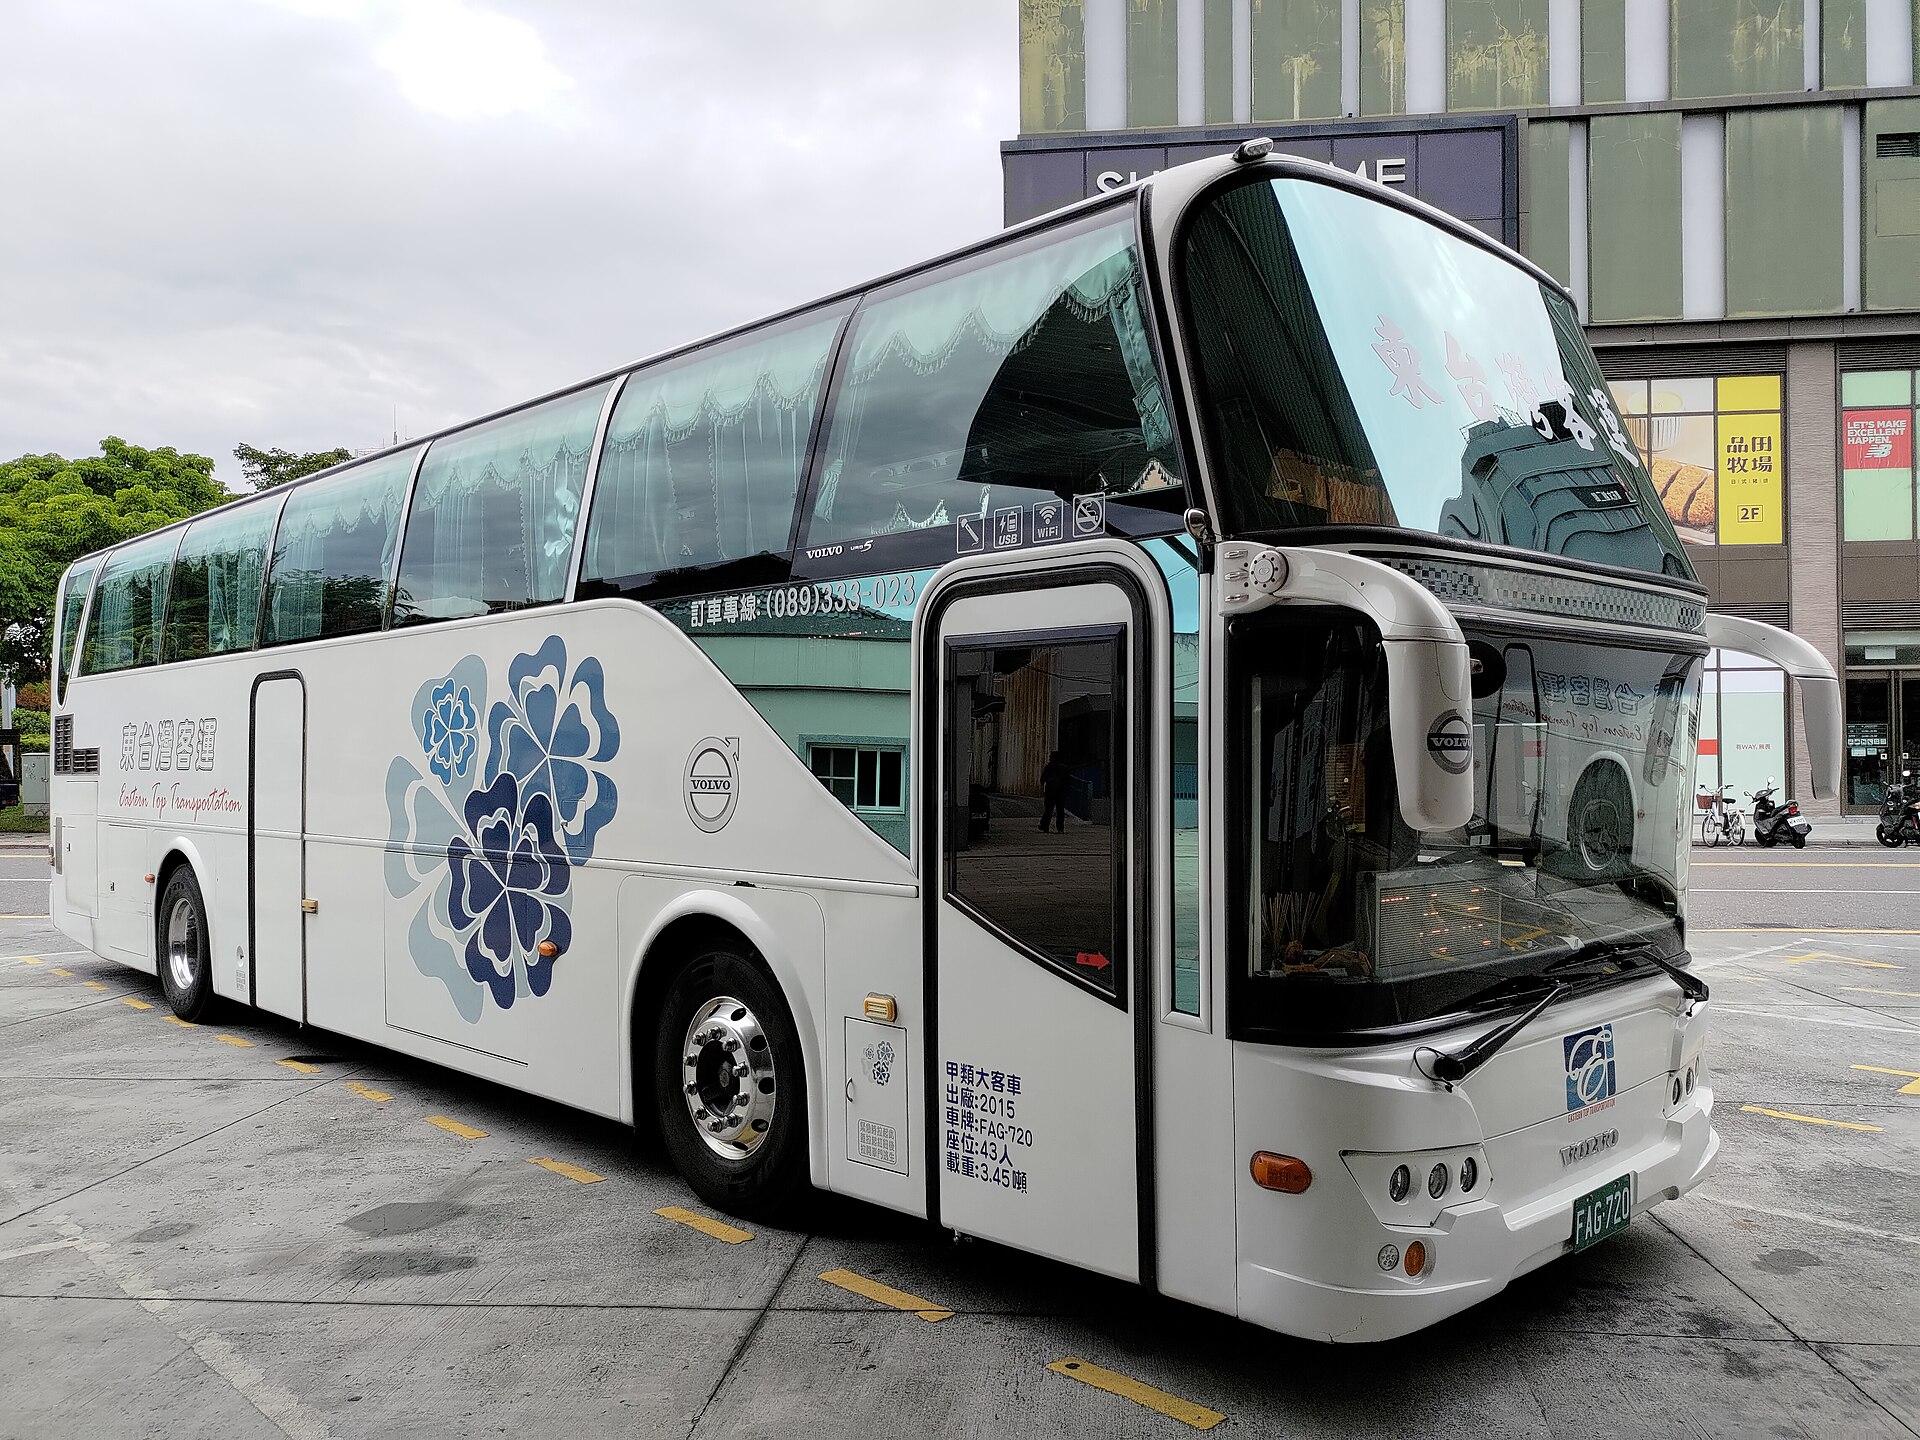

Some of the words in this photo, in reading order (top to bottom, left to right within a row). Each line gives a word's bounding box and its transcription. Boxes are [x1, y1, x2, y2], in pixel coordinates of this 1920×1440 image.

[1847, 421, 1875, 429] LET'S
[1876, 419, 1907, 428] MAKE
[1847, 428, 1906, 437] EXCELLENT
[1847, 436, 1892, 445] HAPPEN.
[1740, 507, 1760, 520] 2F
[1036, 527, 1059, 538] WiFi
[998, 534, 1018, 546] USB
[805, 545, 843, 559] VOLVO
[119, 717, 217, 771] 東台灣客運
[691, 779, 731, 790] VOLVO
[119, 782, 149, 807] Eastern
[152, 782, 167, 819] Top
[171, 782, 242, 822] Transportation
[946, 1061, 1022, 1096] 甲類大客車
[946, 1083, 1016, 1119] 出廠:2015
[946, 1106, 1033, 1147] 車牌:FAG-720
[946, 1129, 1013, 1167] 座位:43人
[1560, 1128, 1619, 1166] VOLVO
